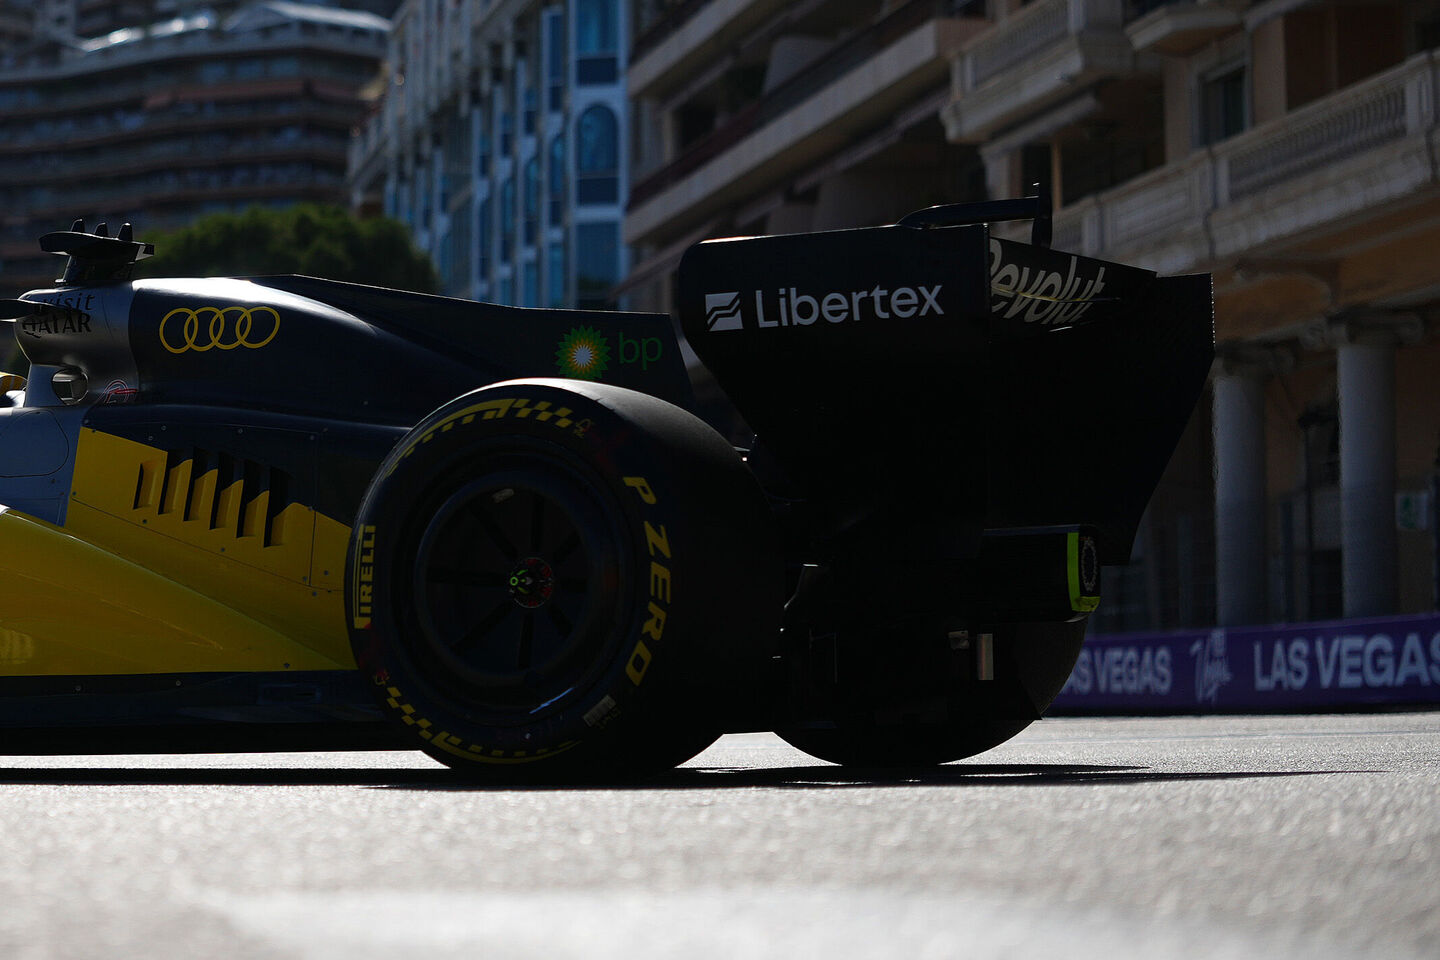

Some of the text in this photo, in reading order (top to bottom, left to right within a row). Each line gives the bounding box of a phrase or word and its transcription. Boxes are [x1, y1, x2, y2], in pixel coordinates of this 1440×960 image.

[755, 284, 945, 329] Libertex
[617, 331, 663, 371] bp
[353, 523, 376, 630] PIRELLI
[623, 520, 671, 687] ZERO
[1094, 646, 1173, 695] VEGAS
[1253, 638, 1311, 690] LAS
